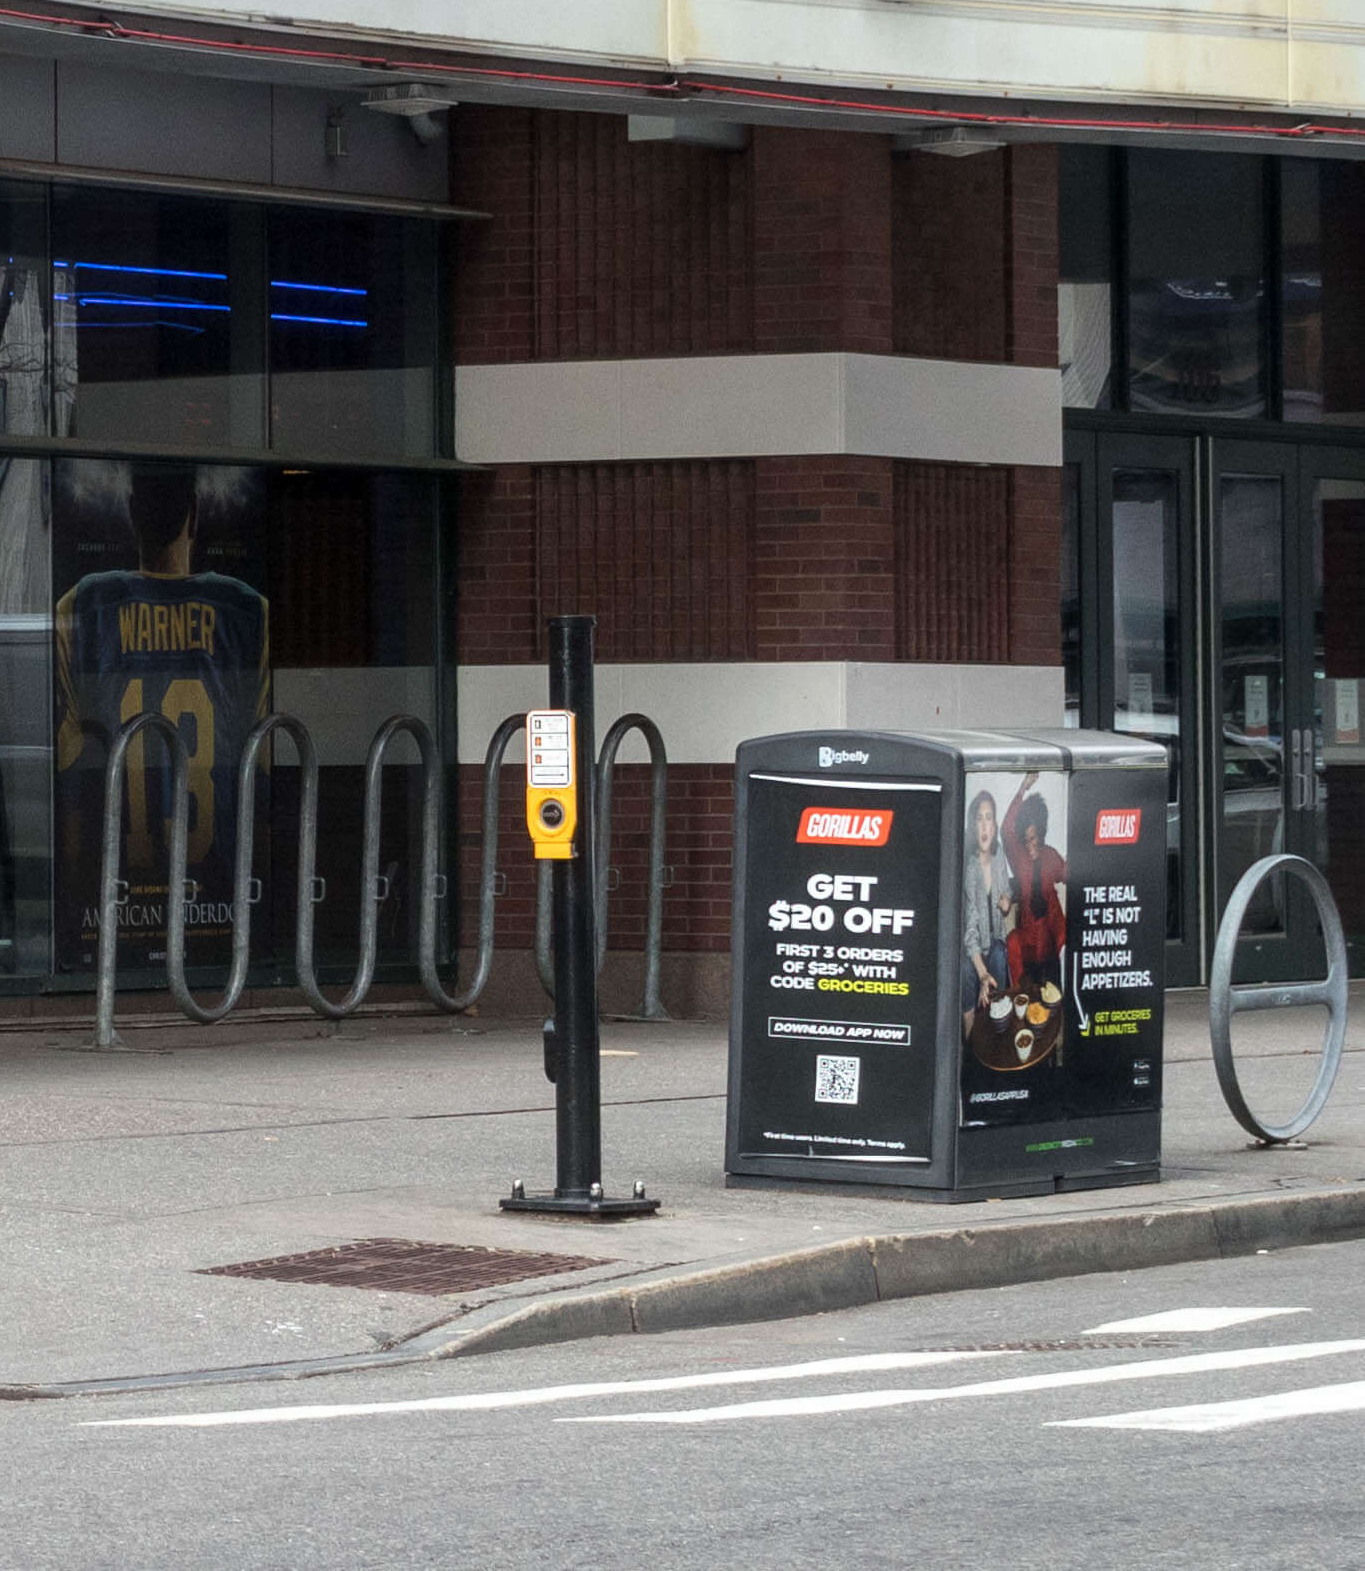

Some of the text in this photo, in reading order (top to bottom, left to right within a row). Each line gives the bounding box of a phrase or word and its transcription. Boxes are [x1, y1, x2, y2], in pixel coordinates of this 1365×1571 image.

[118, 601, 217, 655] WARNER
[819, 746, 869, 768] Bigbelly
[119, 678, 216, 868] 13
[806, 813, 883, 841] GORILLAS
[1099, 814, 1136, 839] GORILLAS
[806, 873, 879, 903] GET
[1083, 885, 1138, 903] THE REAL
[82, 904, 162, 928] AMRICAN
[768, 899, 915, 936] $20 OFF
[1102, 908, 1114, 924] IS
[1115, 907, 1141, 924] NOT
[1082, 929, 1128, 947] HAVING
[776, 942, 904, 963] FIRST 3 ORDERS
[1082, 950, 1131, 969] ENOUGH
[782, 960, 805, 974] OF
[851, 964, 897, 979] WITH
[770, 975, 910, 996] CODE GROCERIES
[1081, 971, 1153, 991] APPETIZERS.
[1094, 1008, 1152, 1023] GET GROCERIES
[773, 1021, 906, 1041] DOWNLOAD APP NOW
[1094, 1024, 1103, 1036] IN
